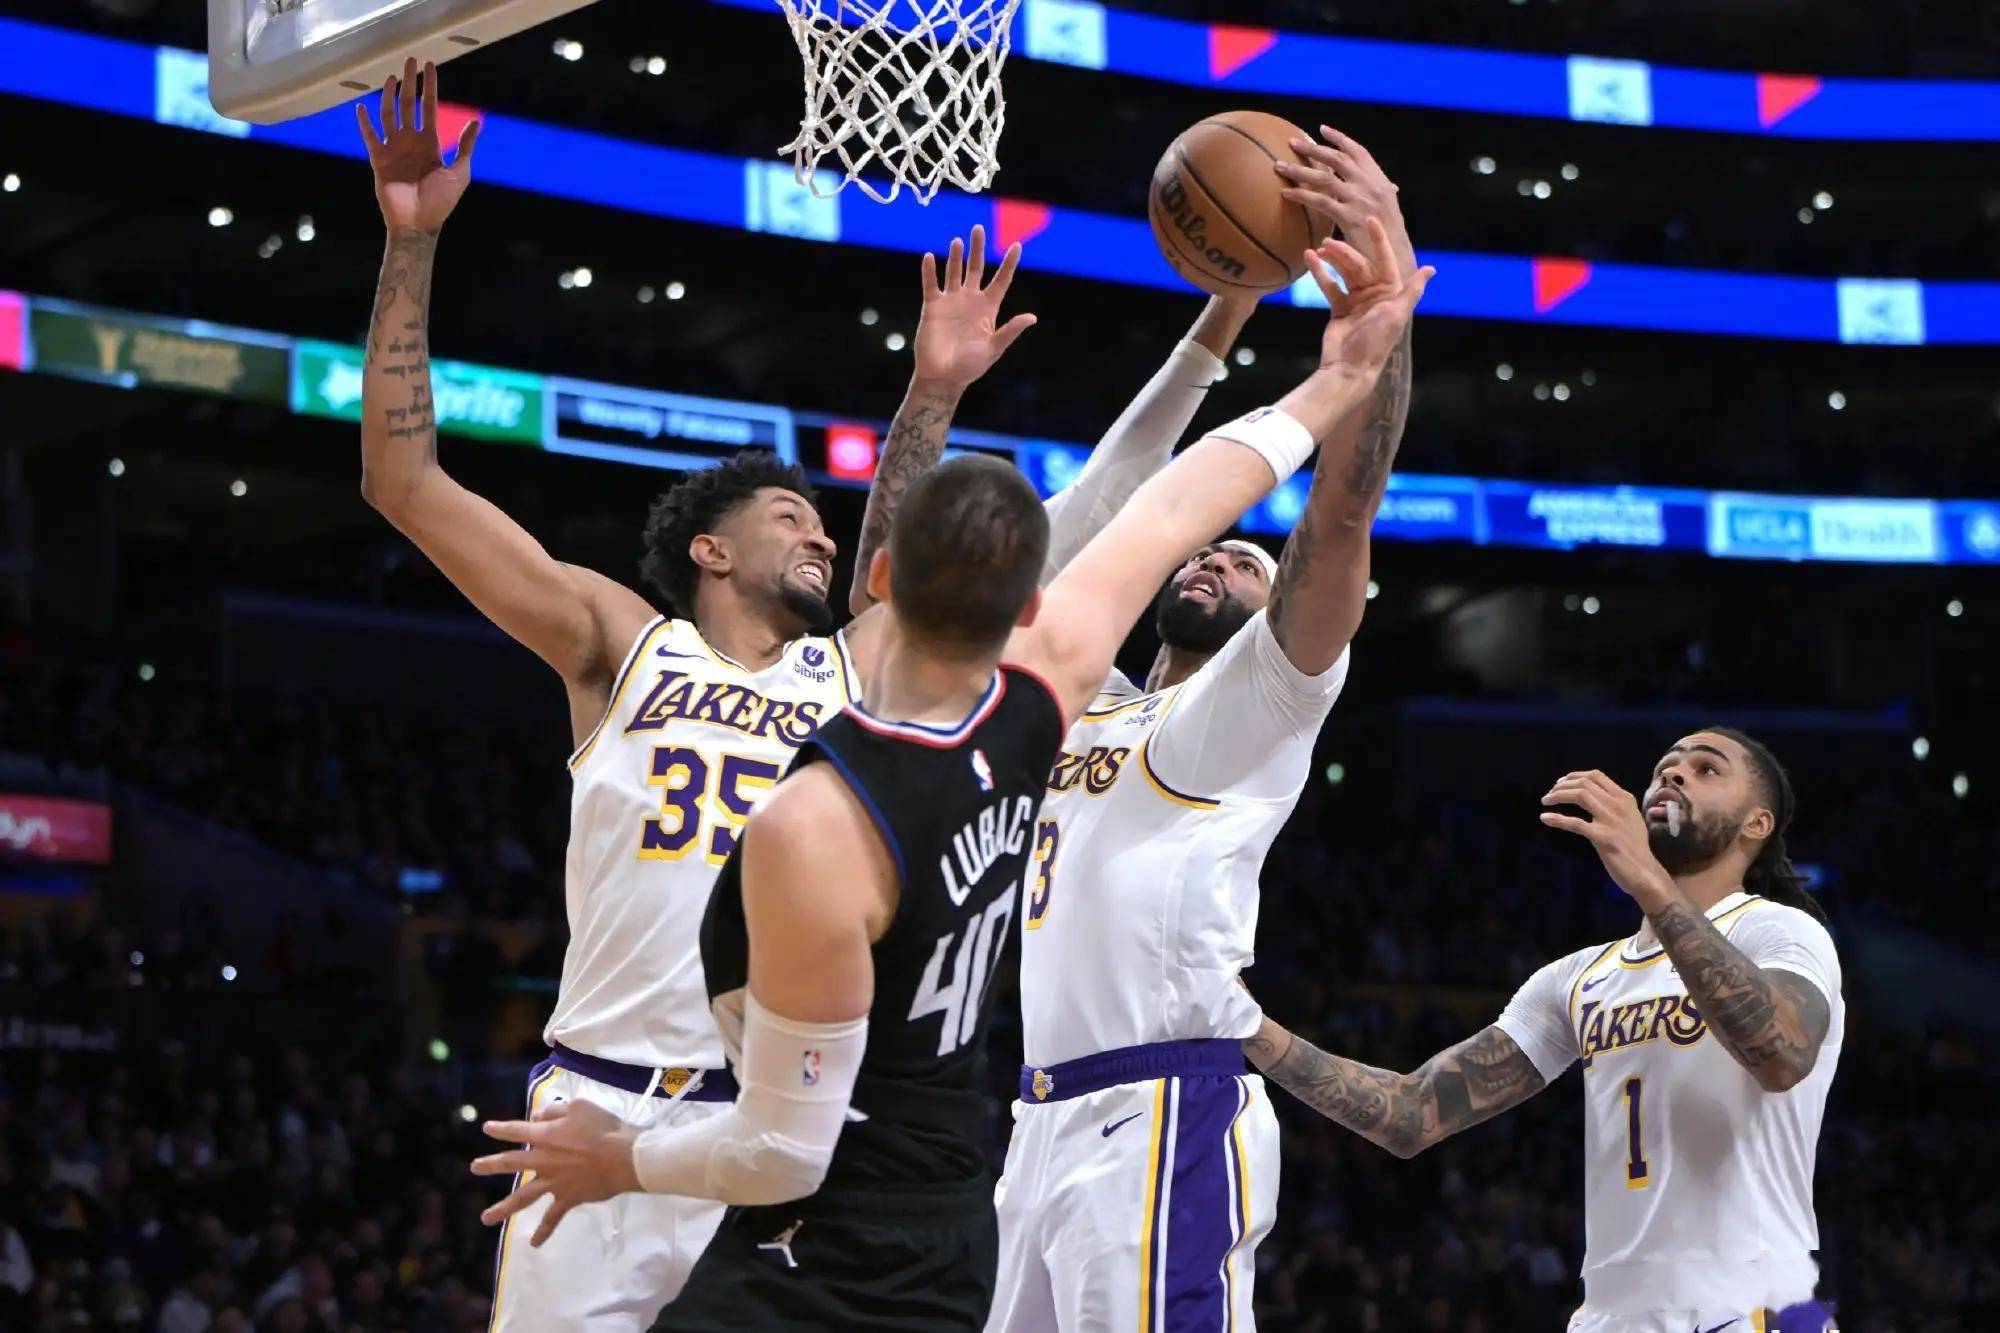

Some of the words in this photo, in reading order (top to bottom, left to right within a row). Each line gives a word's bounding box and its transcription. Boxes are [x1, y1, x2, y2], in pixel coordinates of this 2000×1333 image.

[1161, 176, 1246, 278] Wilson
[623, 669, 824, 749] LAKERS
[794, 660, 835, 683] bibigo
[637, 744, 784, 868] 35
[1024, 816, 1060, 932] 3
[906, 879, 1017, 1058] 40
[1579, 993, 1707, 1072] LAKERS
[1624, 1075, 1650, 1190] 1
